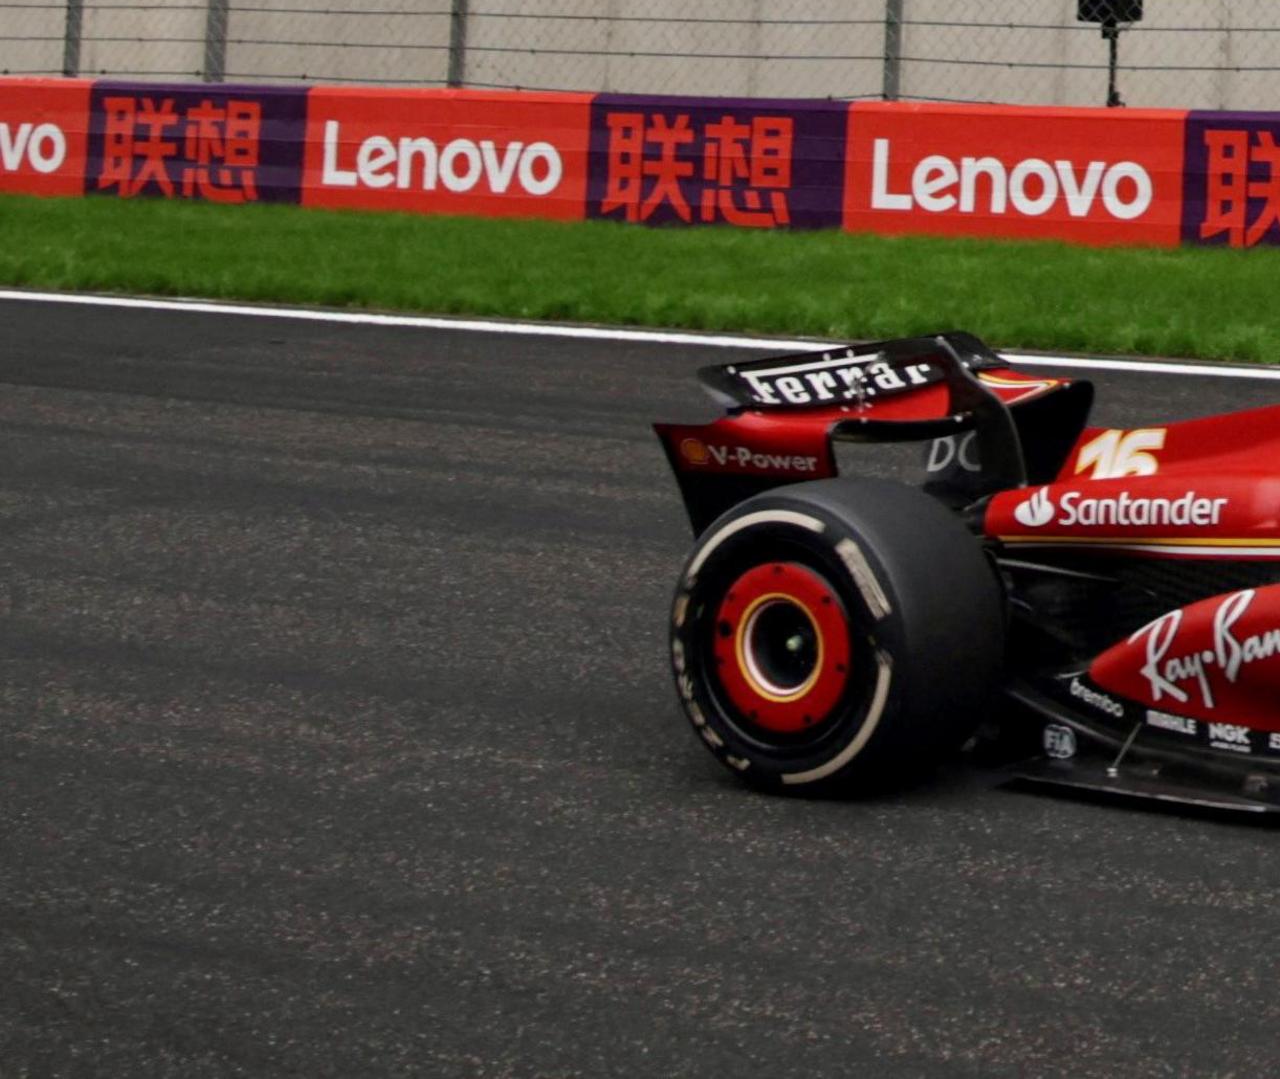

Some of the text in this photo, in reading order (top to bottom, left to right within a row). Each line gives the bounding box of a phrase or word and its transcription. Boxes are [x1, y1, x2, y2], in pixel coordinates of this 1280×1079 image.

[99, 96, 262, 204] 联想
[322, 120, 563, 195] Lenovo
[601, 113, 794, 228] 联想
[871, 138, 1153, 220] Lenovo
[708, 444, 818, 472] V-Power
[1075, 428, 1168, 480] 16
[1058, 491, 1229, 526] Santander
[1070, 676, 1124, 718] brembo
[1208, 722, 1250, 745] NGK
